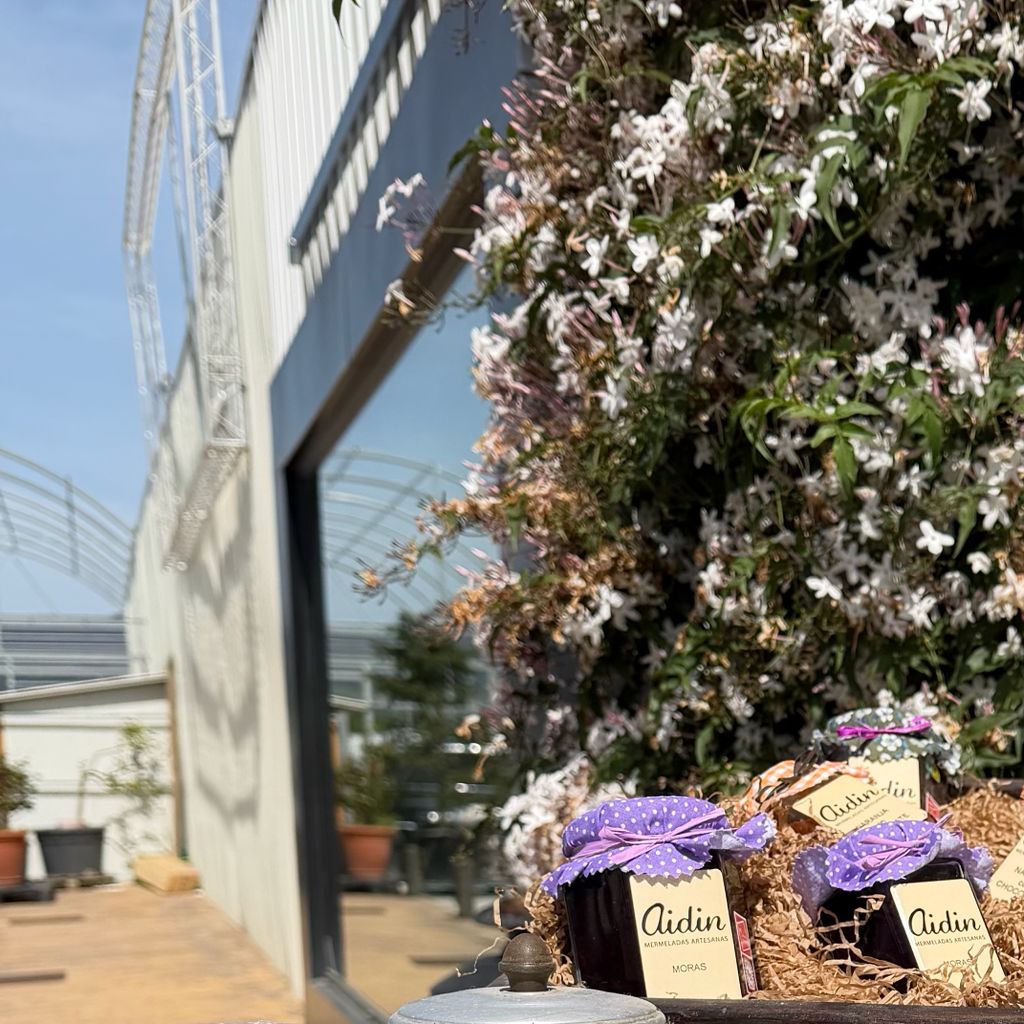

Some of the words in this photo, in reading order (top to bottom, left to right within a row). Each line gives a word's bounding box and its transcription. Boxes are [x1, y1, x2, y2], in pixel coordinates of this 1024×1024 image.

[820, 788, 880, 822] Aidin
[642, 903, 726, 936] Aidin
[908, 908, 980, 936] Aidin
[644, 940, 690, 948] MERMELADAS
[691, 936, 729, 944] ARTESANAS
[916, 939, 953, 947] MERMELADAS
[954, 935, 986, 943] ARTESANAS
[672, 963, 707, 973] MORAS
